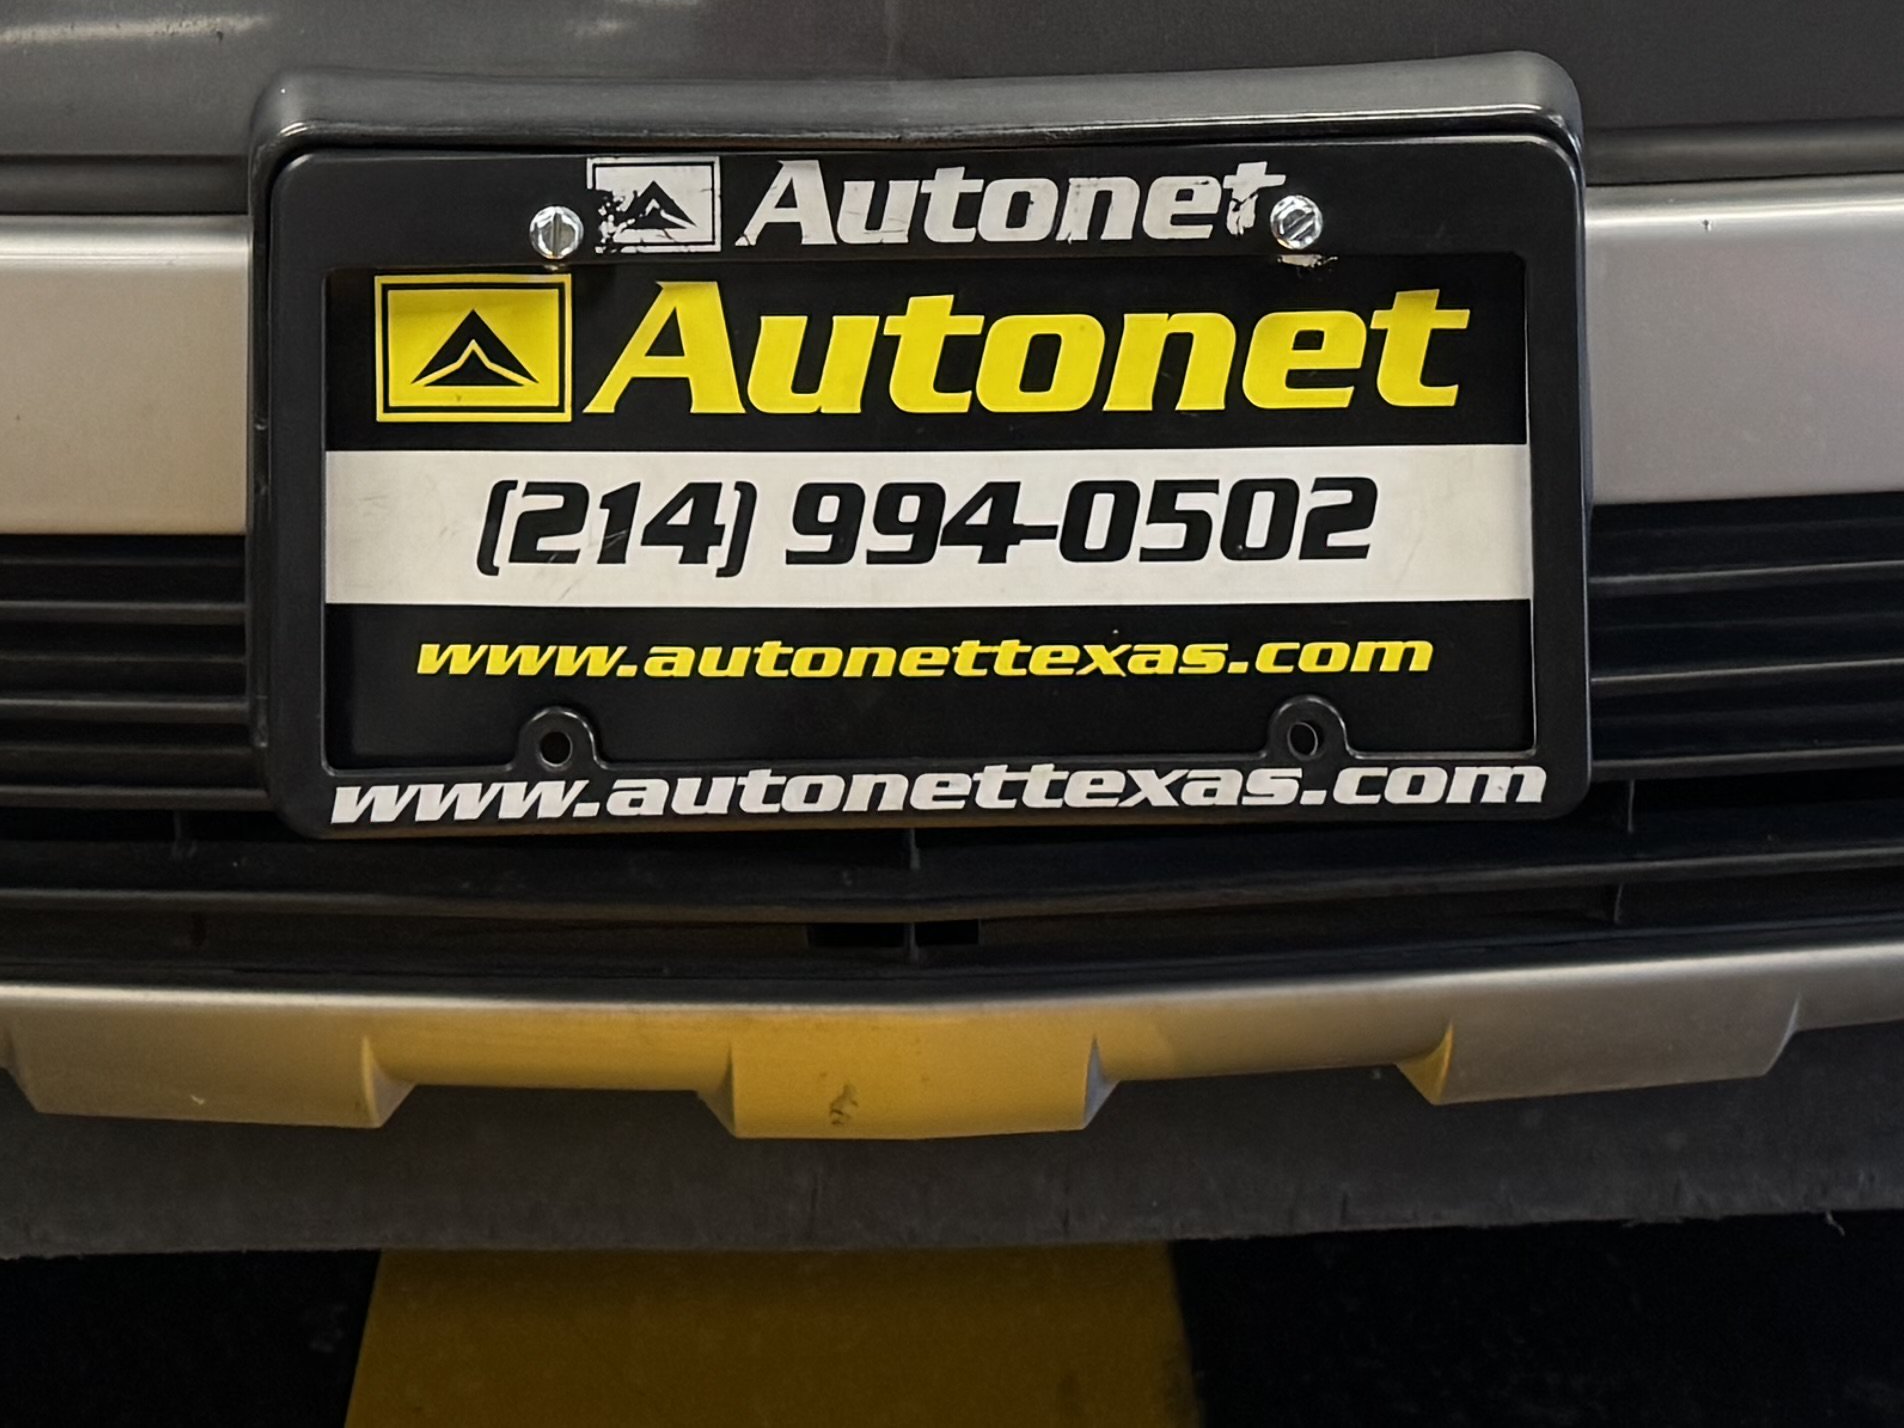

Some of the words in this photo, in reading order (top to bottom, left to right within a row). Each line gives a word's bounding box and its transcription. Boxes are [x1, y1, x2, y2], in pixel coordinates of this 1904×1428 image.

[735, 158, 1287, 247] Autonet
[582, 281, 1471, 414] Autonet
[476, 479, 757, 579] (214)
[785, 476, 1379, 566] 994-0502
[417, 639, 1434, 679] www.autonettexas.com
[330, 763, 1548, 825] www.autonettexas.com
